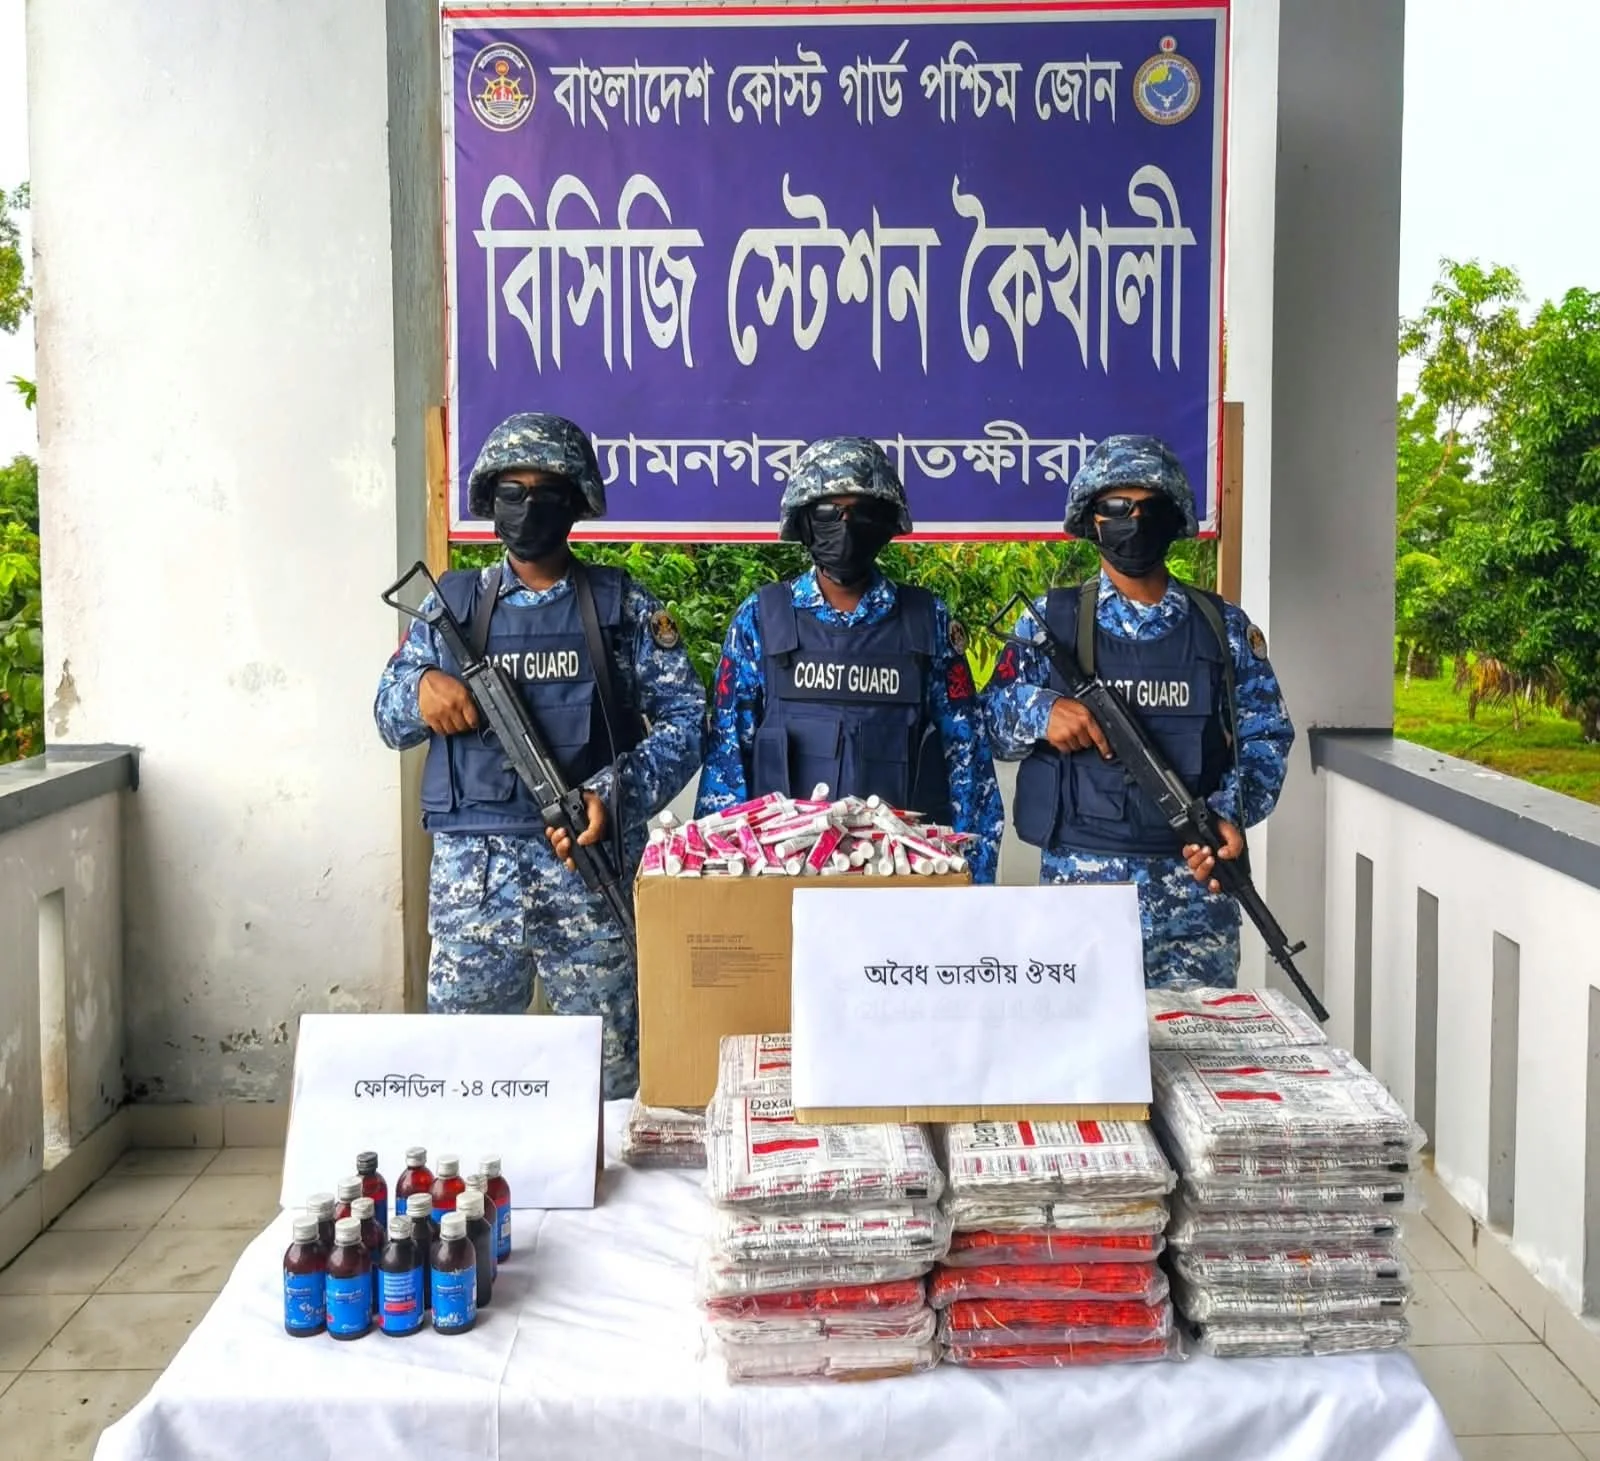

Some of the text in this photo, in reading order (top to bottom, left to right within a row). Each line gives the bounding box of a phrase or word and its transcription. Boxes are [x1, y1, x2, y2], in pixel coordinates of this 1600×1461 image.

[549, 57, 715, 131] বাংলাদেশ
[727, 42, 828, 127] কোস্ট
[839, 39, 909, 125] গার্ড
[919, 40, 1023, 124] পশ্চিম
[1035, 52, 1123, 124] জোন
[472, 164, 1198, 376] বিসিজি স্টেশন কৈখালী
[524, 651, 579, 680] GUARD
[794, 661, 900, 695] COAST GUARD
[1136, 679, 1191, 708] GUARD
[864, 956, 1076, 986] অবৈধ ভারতীয় ঔষধ
[354, 1073, 447, 1099] ফেন্সিডিল
[491, 1079, 550, 1098] বোতল
